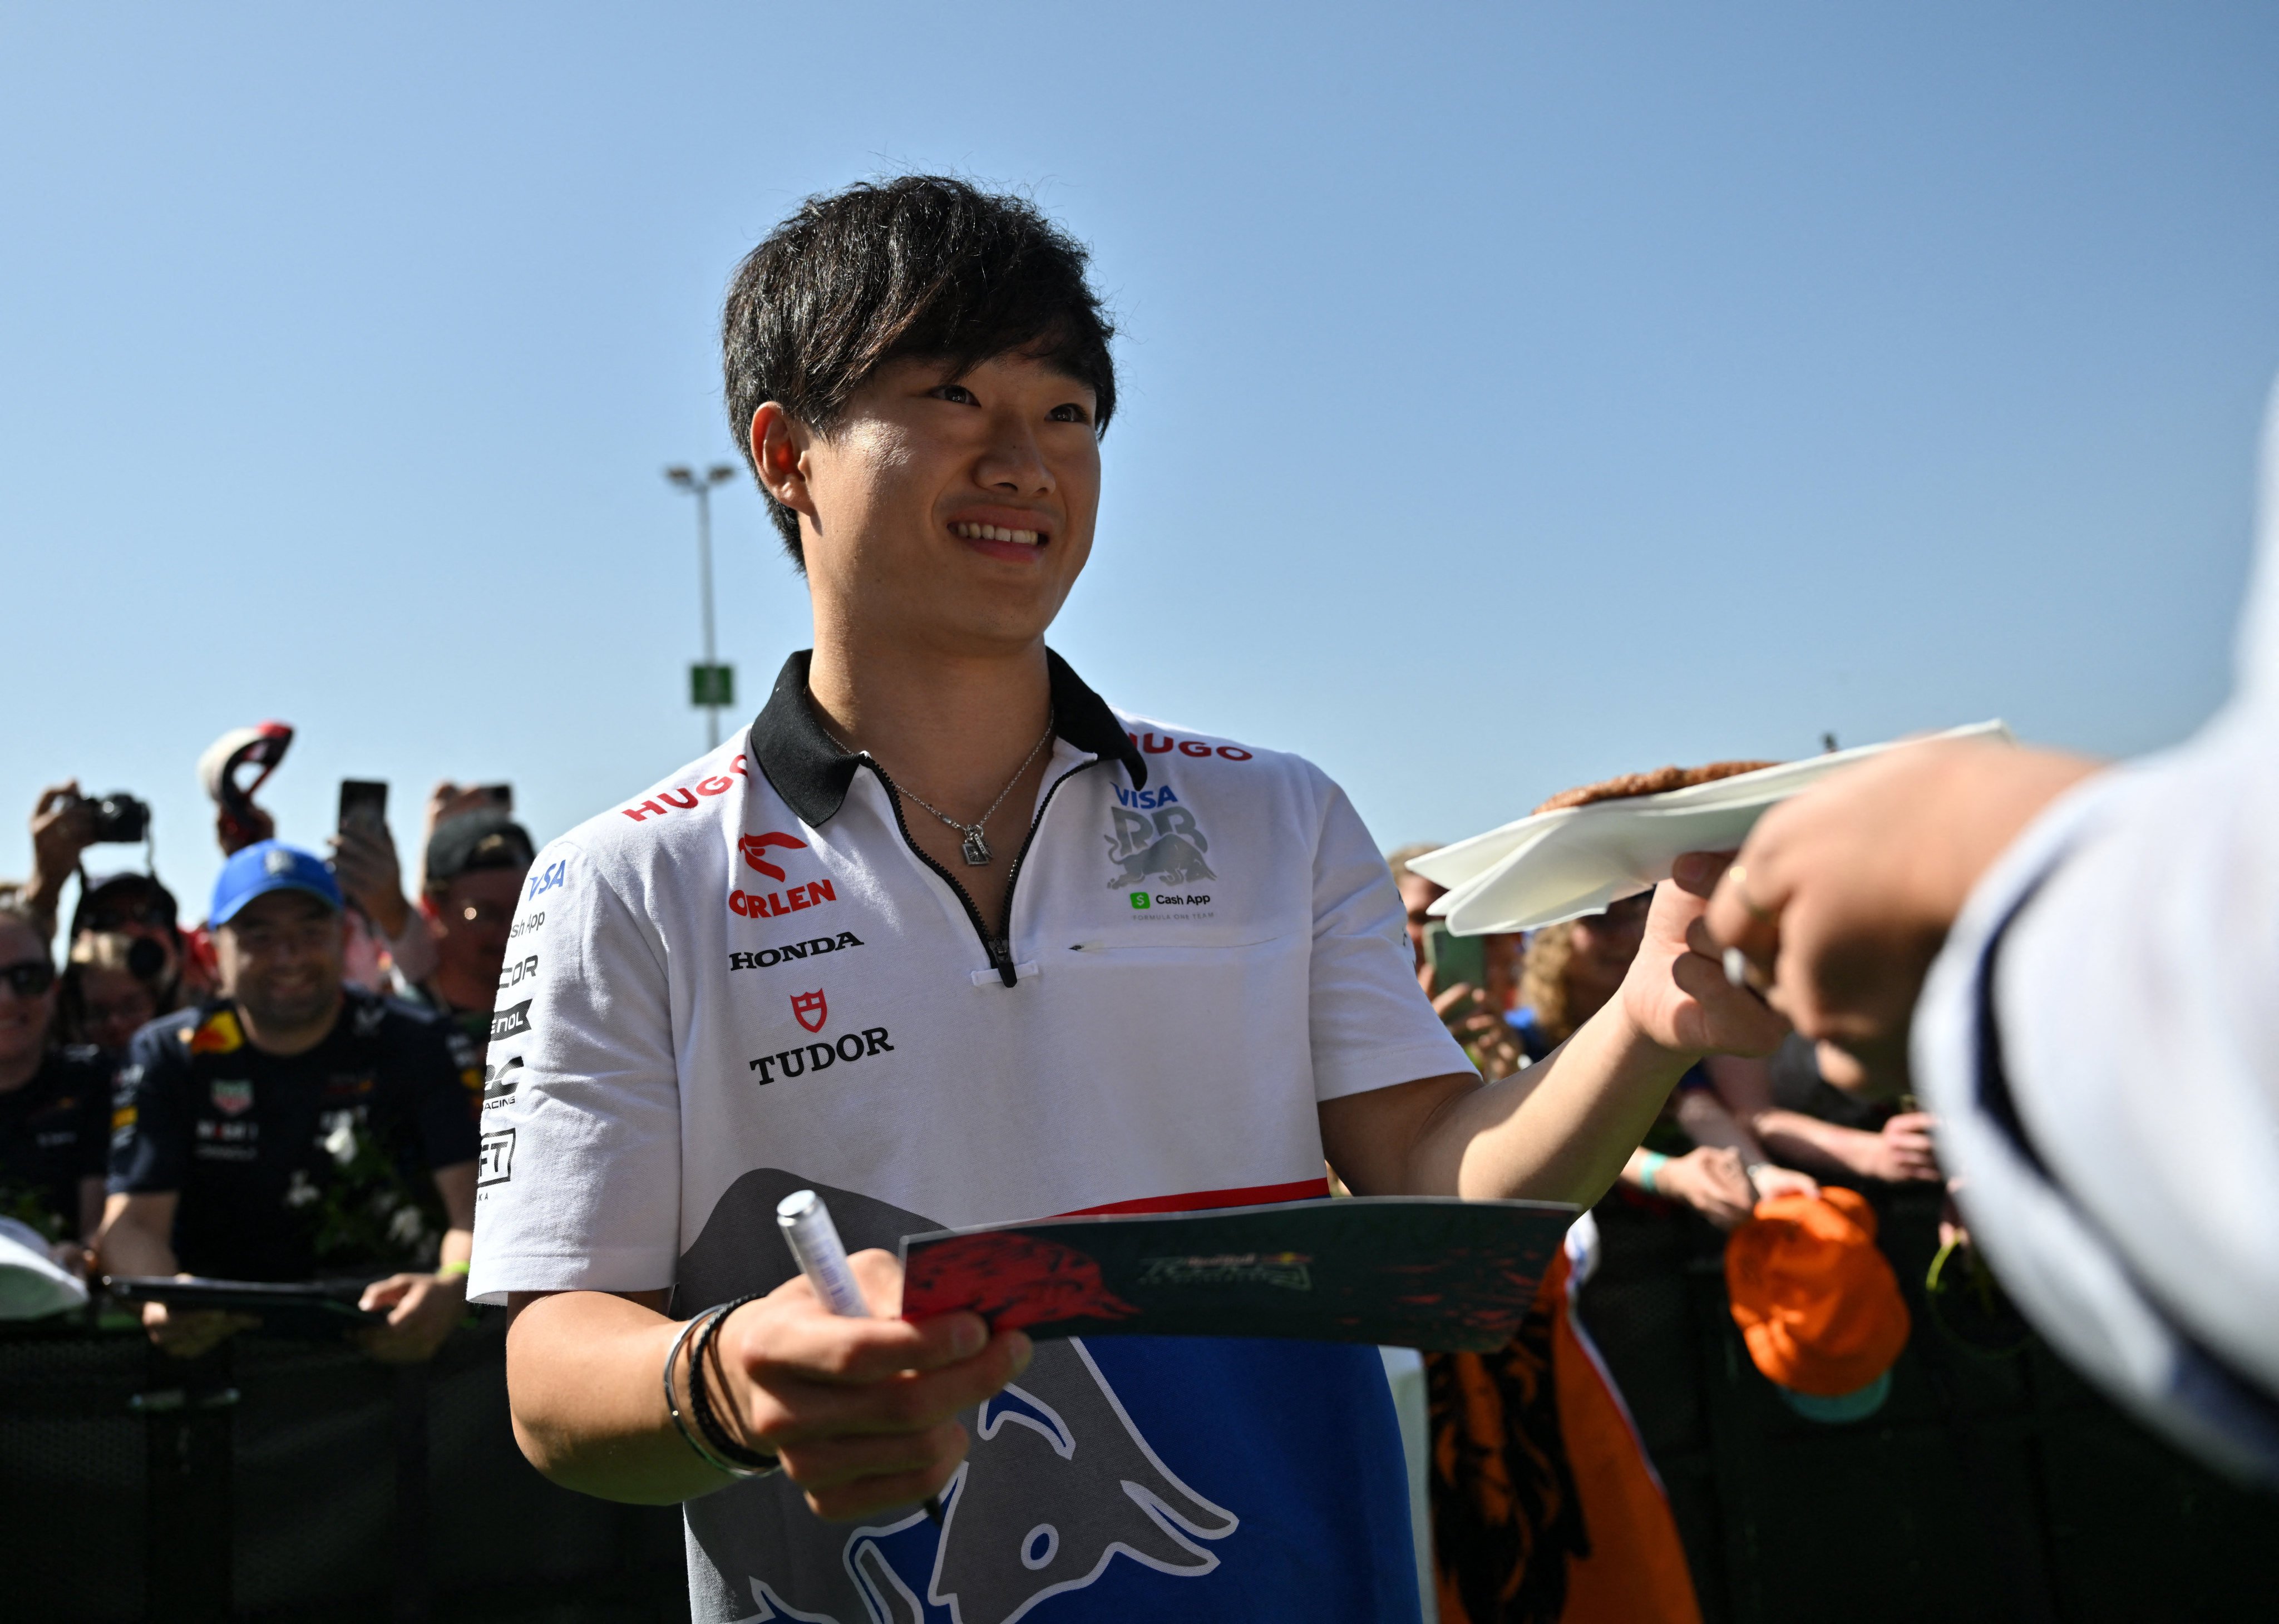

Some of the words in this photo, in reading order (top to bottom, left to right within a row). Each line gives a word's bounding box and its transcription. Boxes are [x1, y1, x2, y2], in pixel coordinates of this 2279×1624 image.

[1109, 781, 1178, 809] VISA
[529, 859, 566, 901] VSA
[728, 879, 837, 919] ORLEN
[1156, 895, 1184, 905] Cash
[1186, 895, 1211, 906] App
[729, 931, 865, 971] HONDA
[749, 1027, 895, 1085] TUDOR
